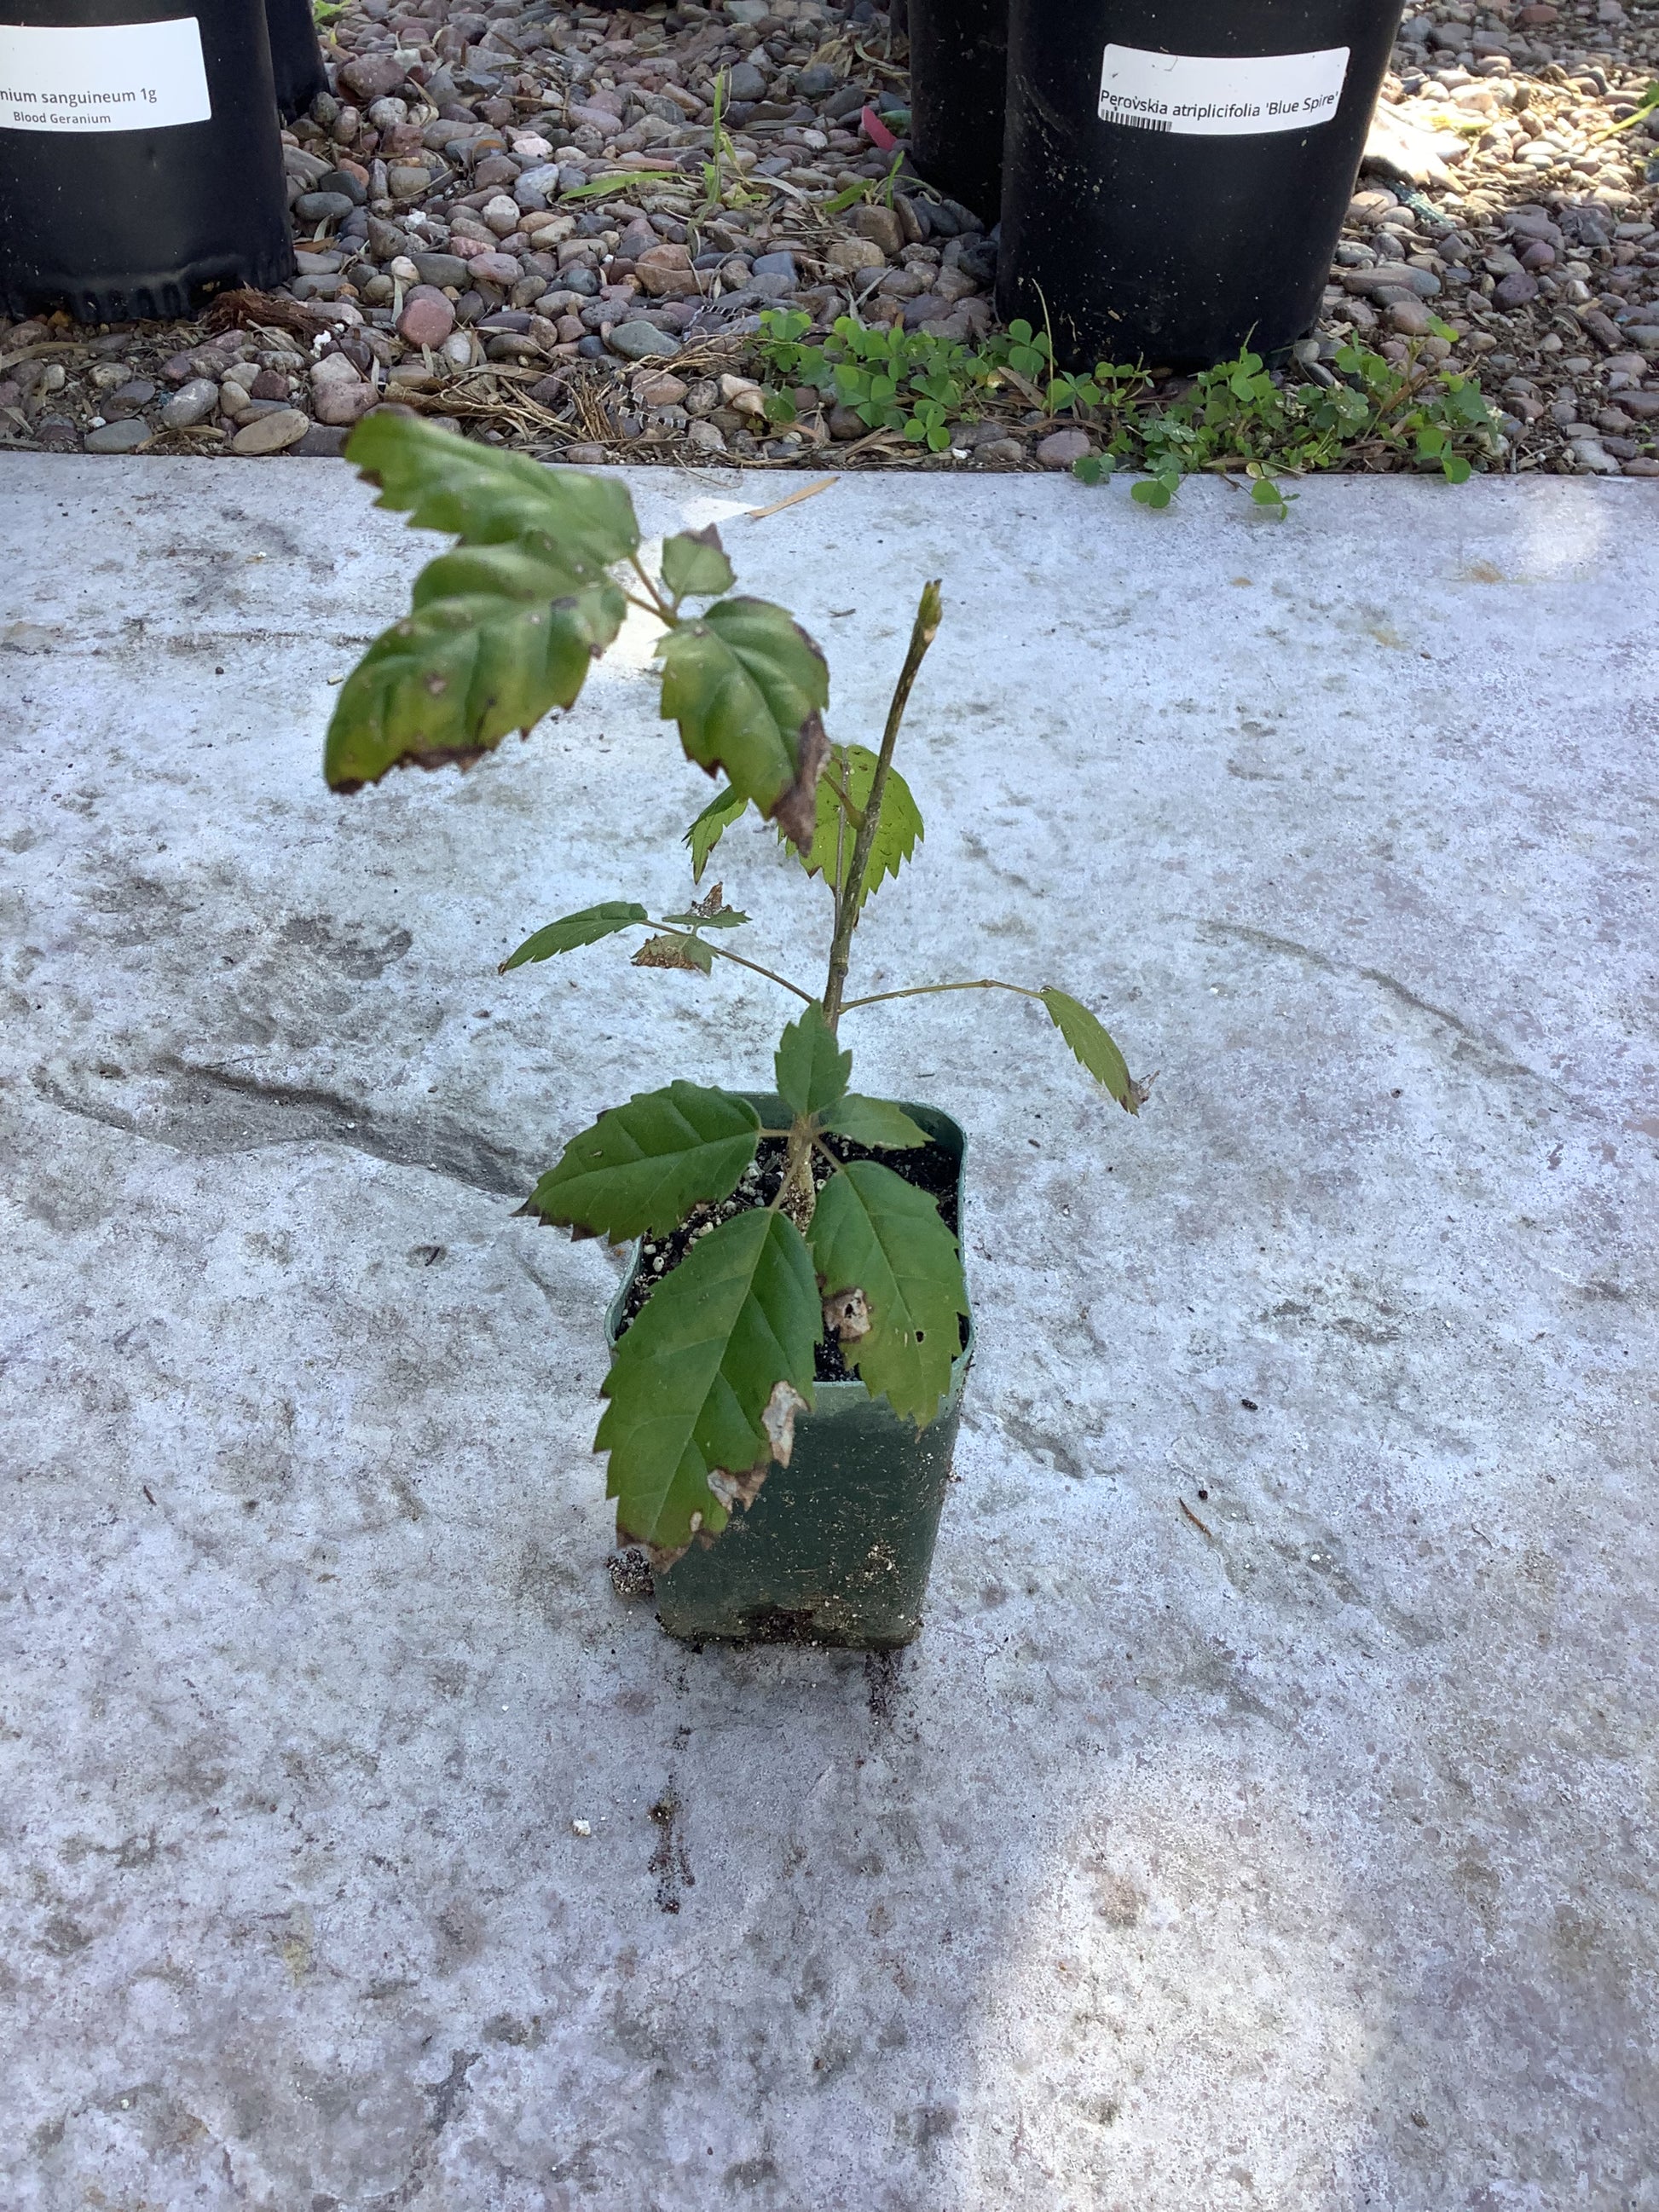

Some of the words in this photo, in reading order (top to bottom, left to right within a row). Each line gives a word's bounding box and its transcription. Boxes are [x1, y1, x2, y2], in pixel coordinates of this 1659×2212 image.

[42, 90, 136, 107] sanguineum
[140, 88, 157, 103] 1g
[1101, 90, 1168, 115] Perovskia
[1172, 103, 1261, 121] atriplicifolia
[1265, 100, 1299, 115] 'Blue
[1302, 91, 1338, 113] Spire'
[13, 111, 47, 124] Blood
[49, 113, 112, 124] Geranium
